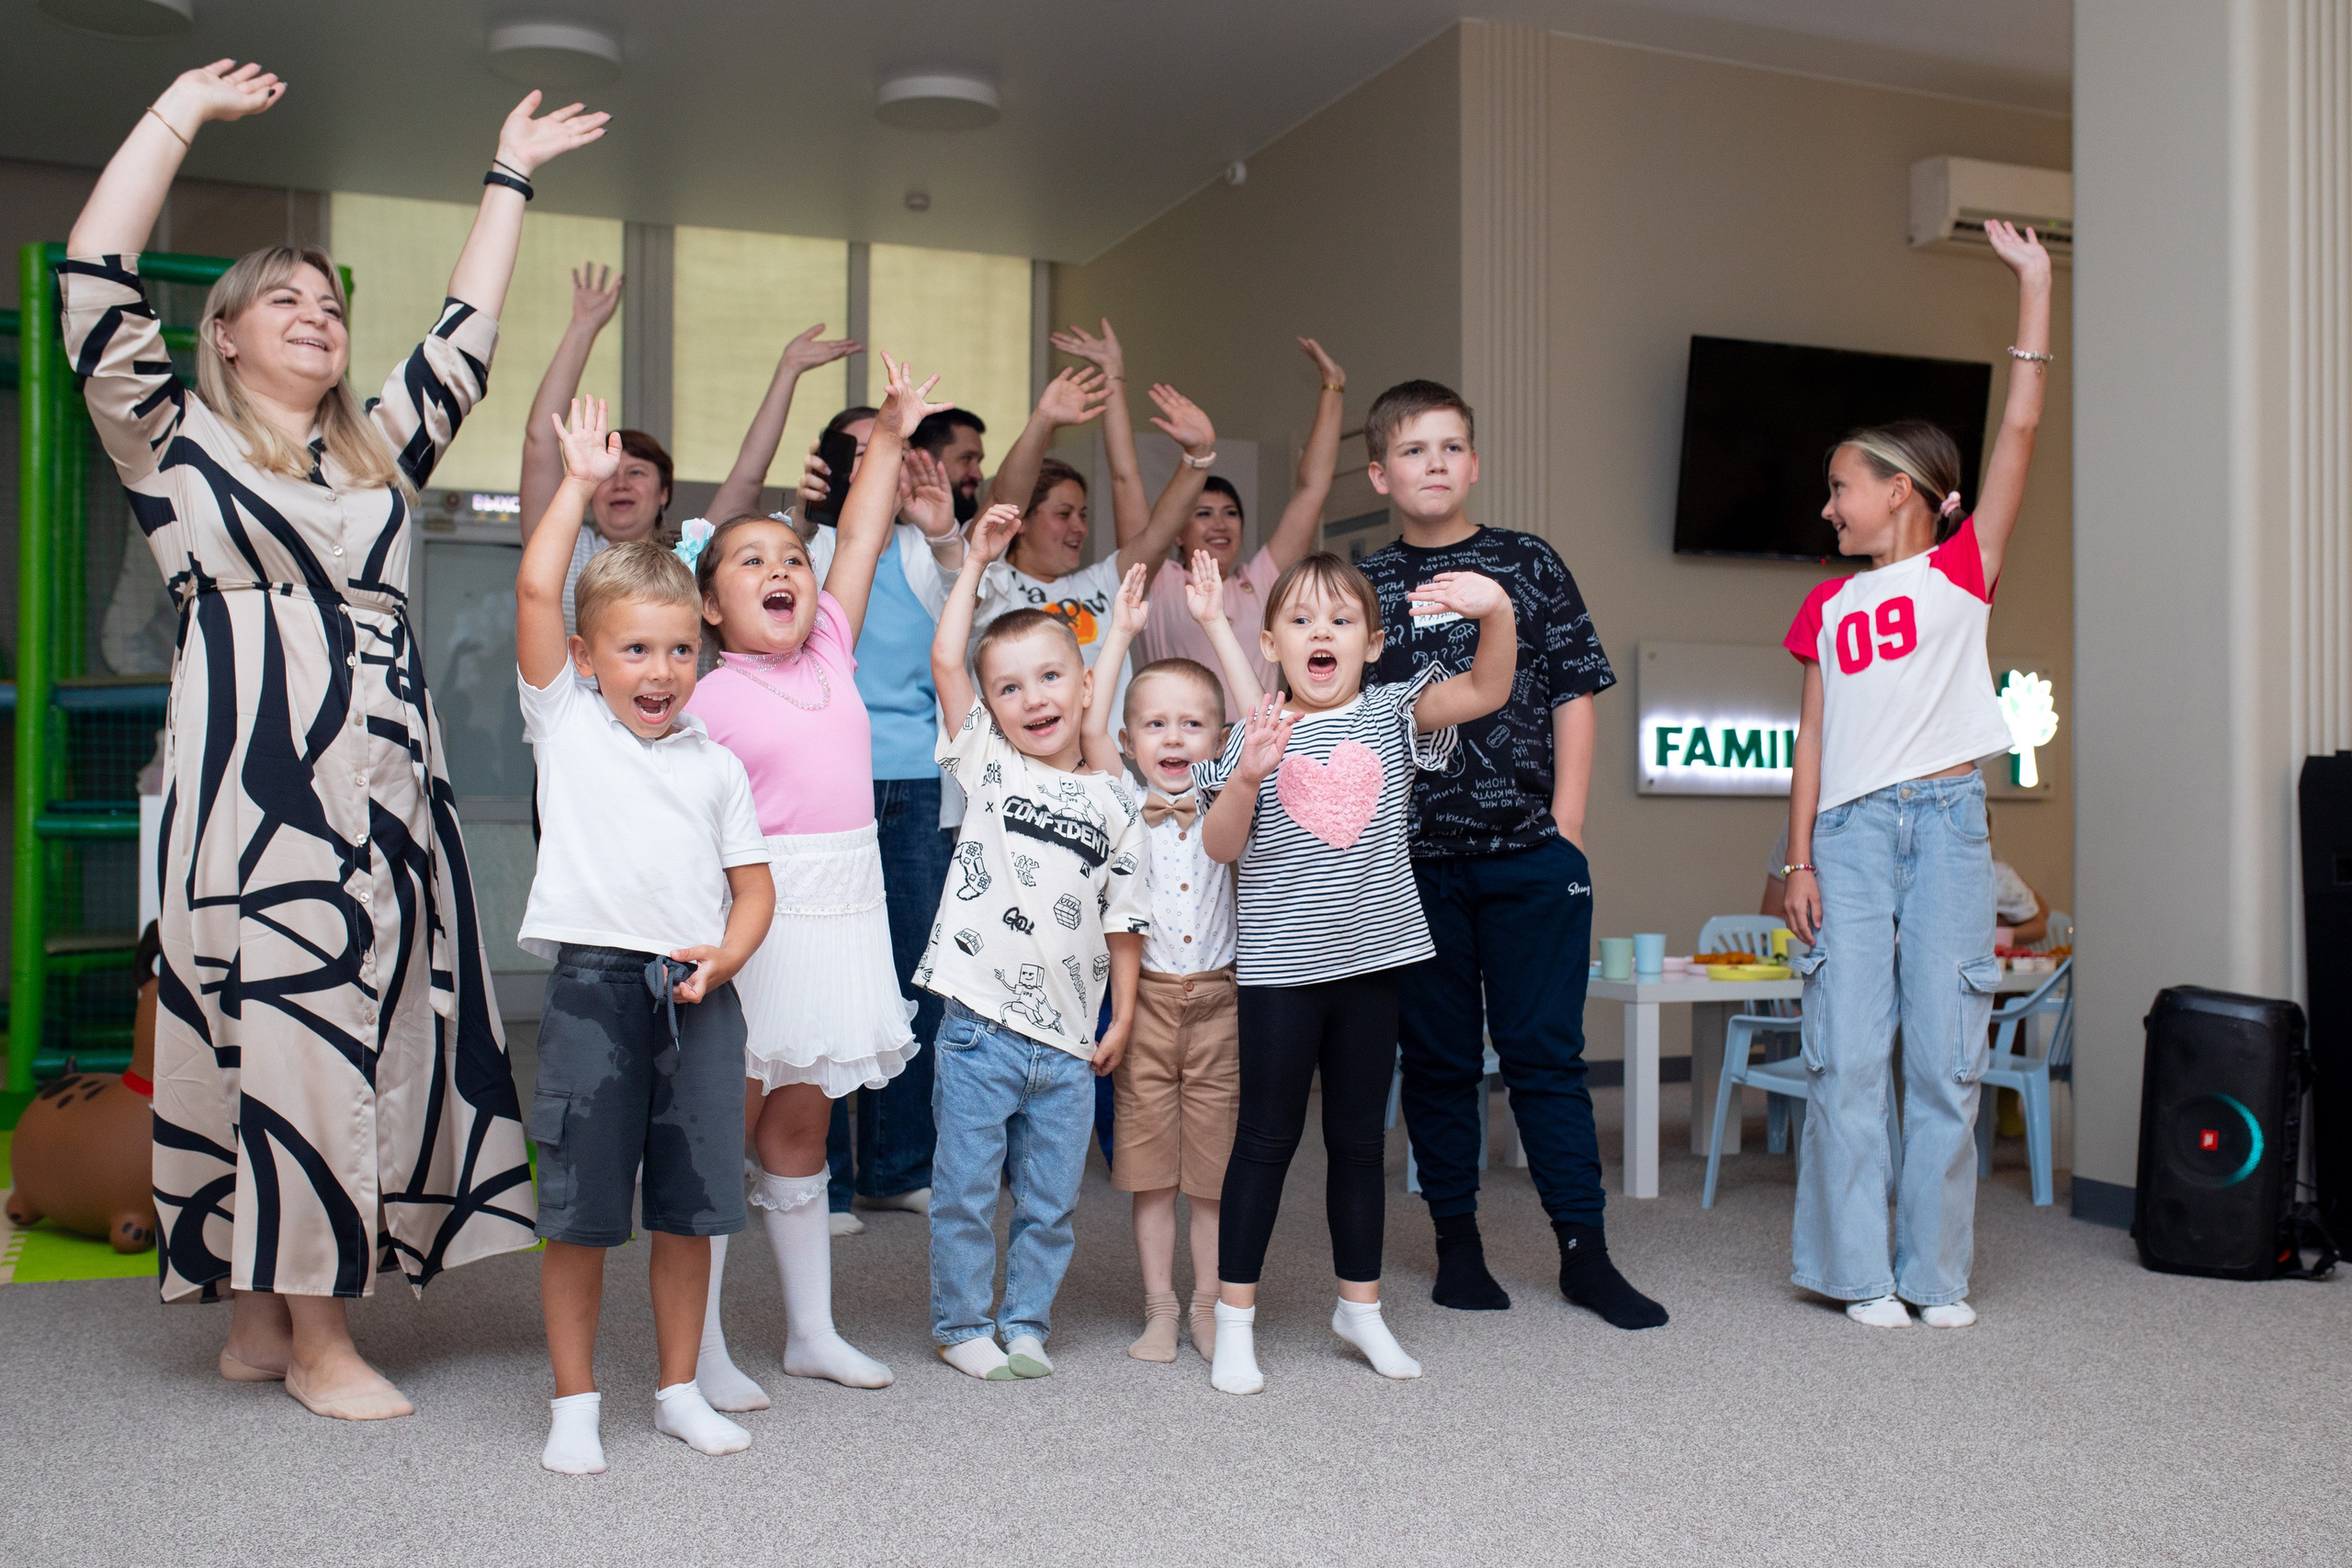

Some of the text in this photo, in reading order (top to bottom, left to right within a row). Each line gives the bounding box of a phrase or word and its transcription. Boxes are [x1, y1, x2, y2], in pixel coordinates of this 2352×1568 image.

[1836, 595, 1917, 675] 09
[1656, 727, 1795, 770] FAMI
[1002, 798, 1110, 858] CONFIDENT
[1002, 906, 1035, 935] GO!
